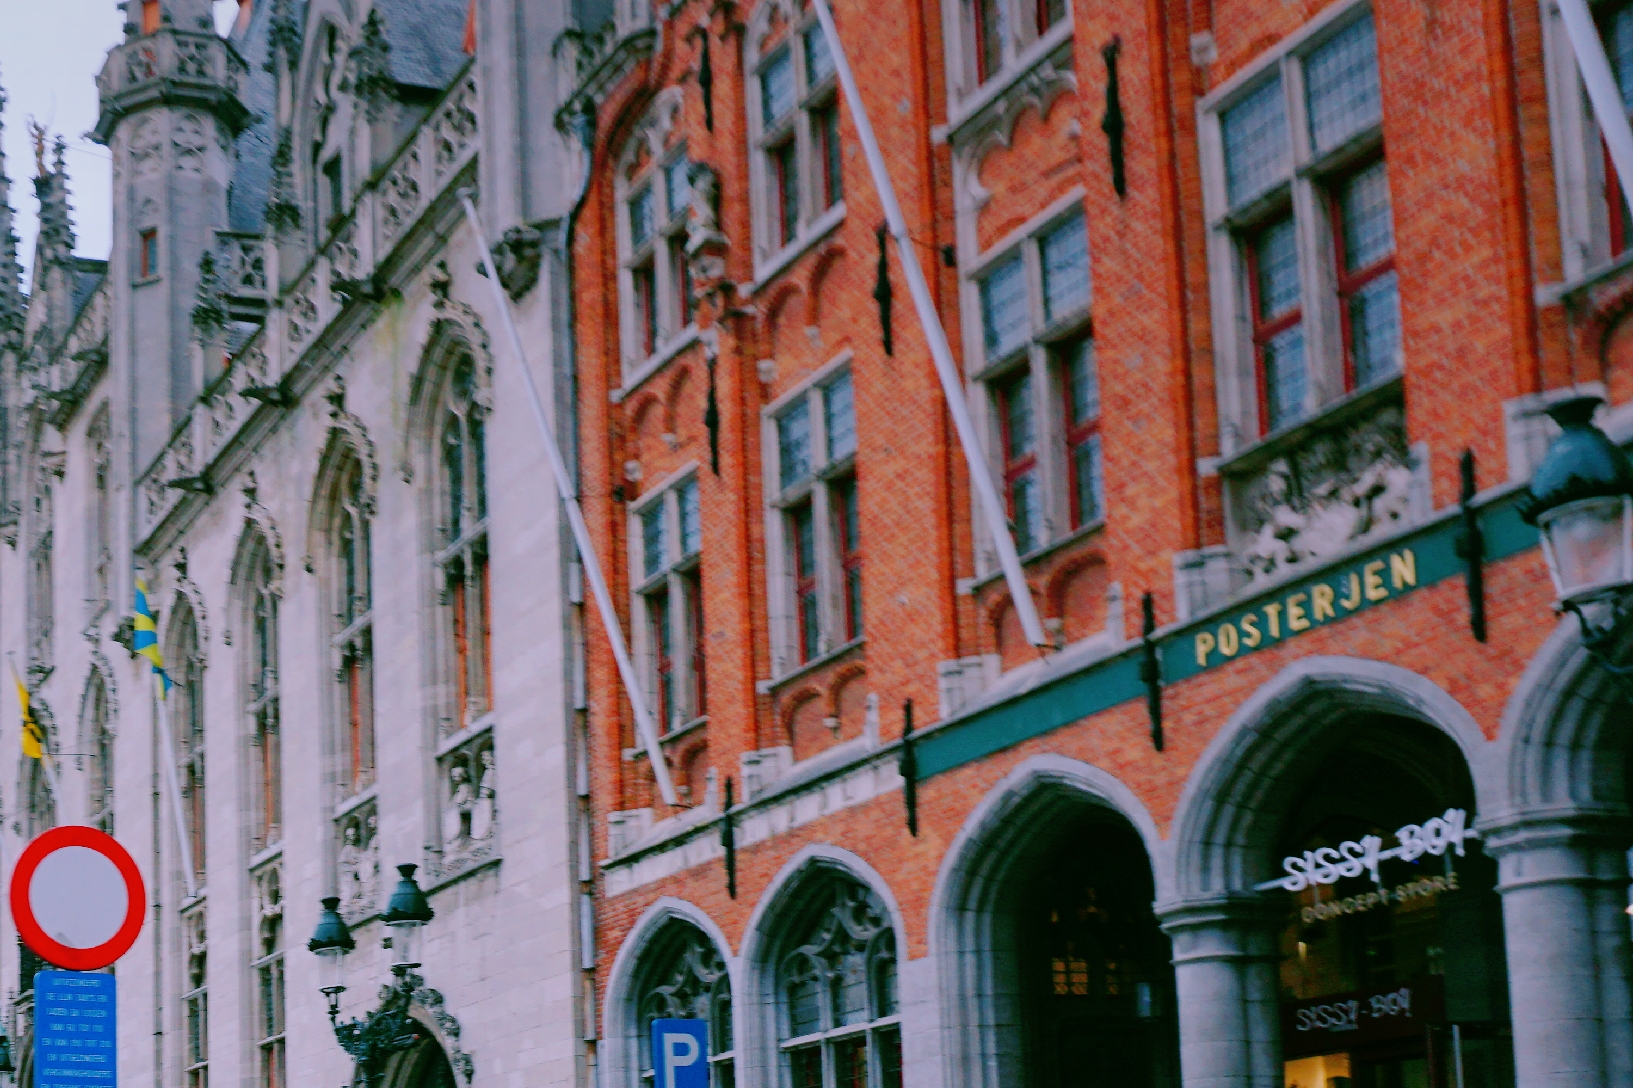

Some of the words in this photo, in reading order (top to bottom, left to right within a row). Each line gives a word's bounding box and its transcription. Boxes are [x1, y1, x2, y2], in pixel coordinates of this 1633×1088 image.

[1193, 548, 1417, 667] POSTERJEN
[1300, 888, 1390, 924] CONCEPT
[1394, 871, 1461, 902] STORE
